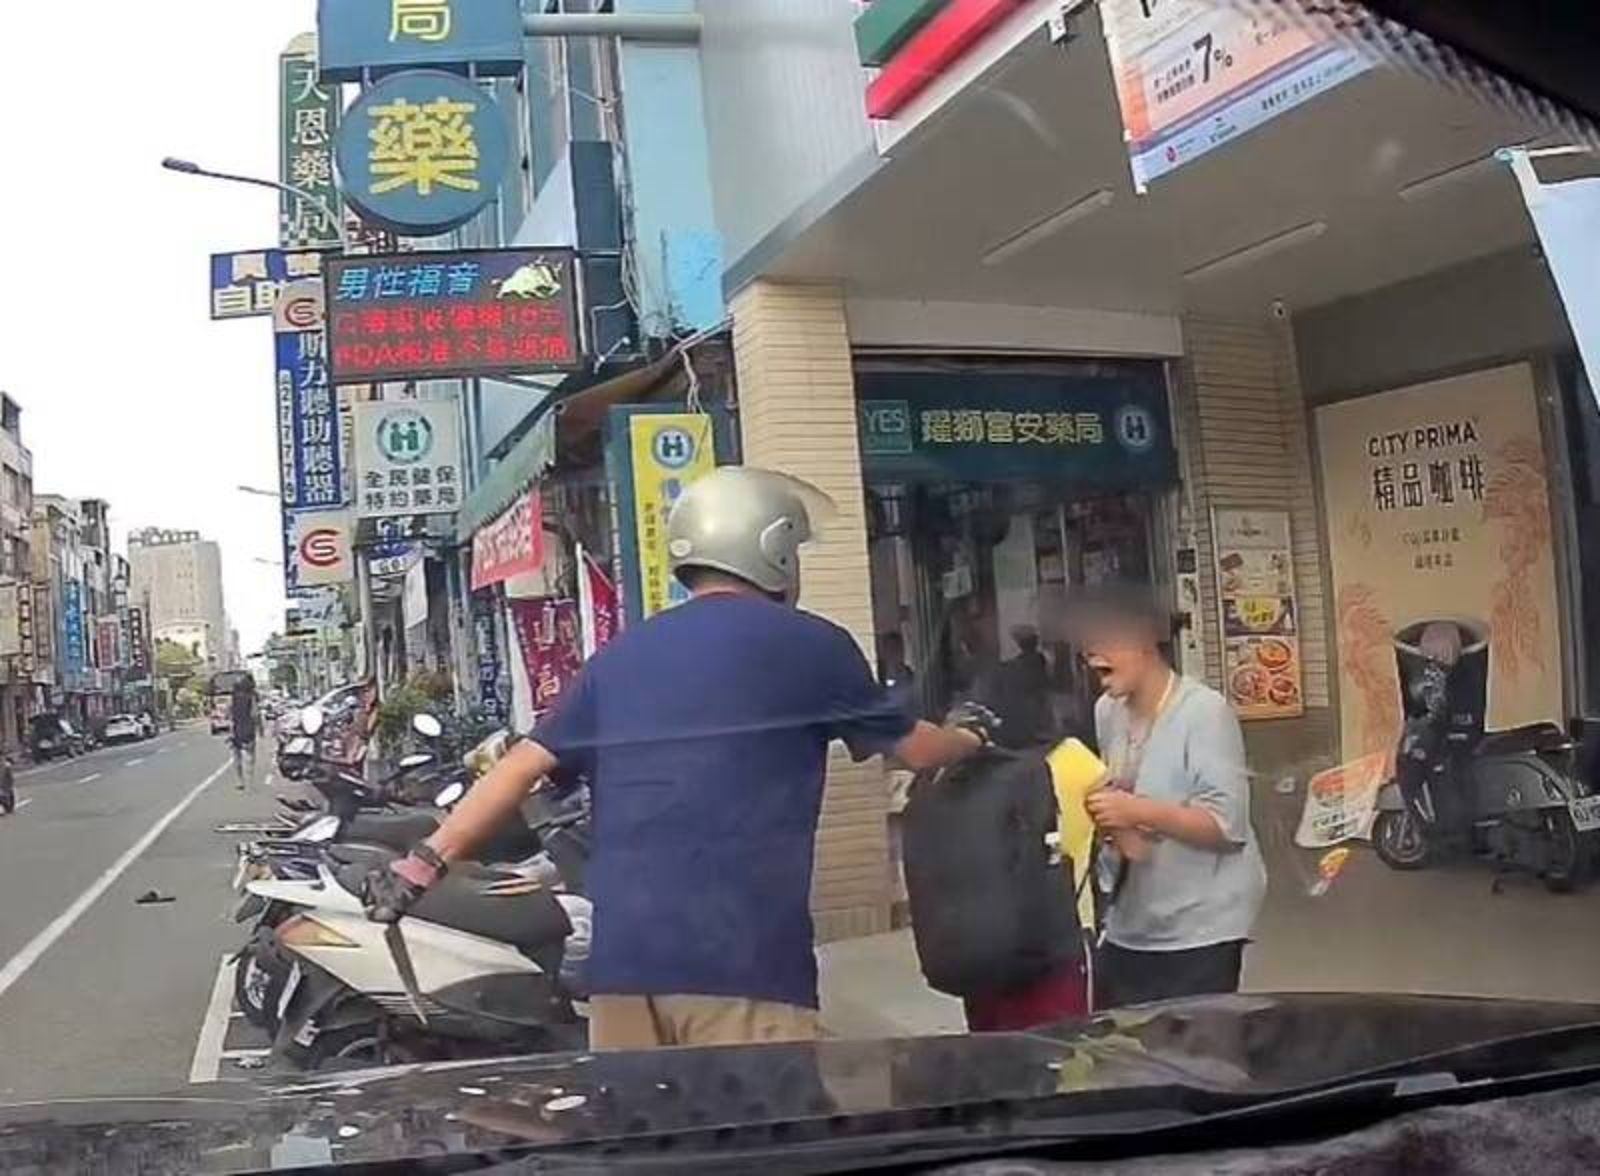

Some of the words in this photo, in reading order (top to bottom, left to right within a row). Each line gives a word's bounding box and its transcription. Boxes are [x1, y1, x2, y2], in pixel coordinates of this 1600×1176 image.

[388, 0, 451, 42] 局
[368, 97, 480, 194] 藥
[337, 261, 481, 301] 男性福音
[1369, 432, 1409, 458] CITY
[1415, 421, 1478, 450] PRIMA
[364, 465, 457, 489] 全民健保
[1373, 454, 1485, 512] 精品咖啡
[365, 486, 456, 510] 特約藥局
